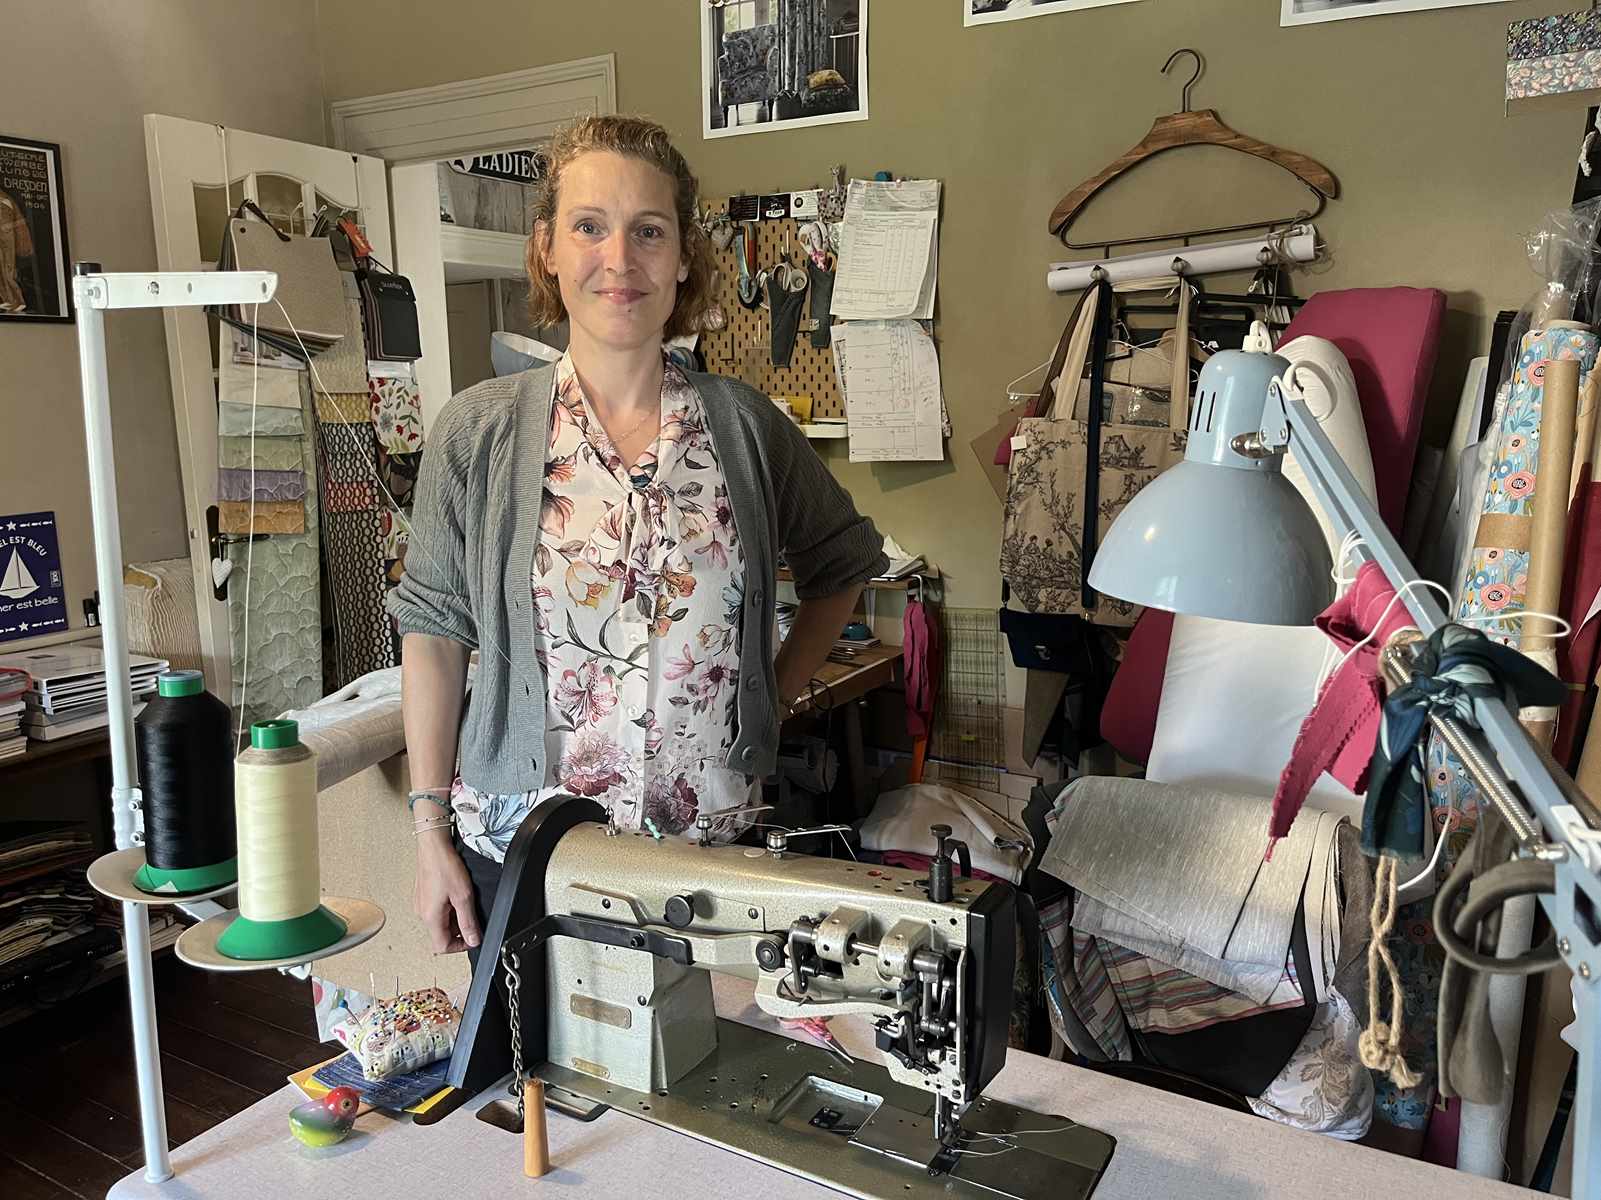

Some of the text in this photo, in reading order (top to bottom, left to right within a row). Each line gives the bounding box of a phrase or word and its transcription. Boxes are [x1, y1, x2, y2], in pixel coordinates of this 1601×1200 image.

[479, 152, 539, 180] LADIES
[4, 177, 47, 192] DRESDEN
[9, 536, 26, 544] EST
[27, 539, 47, 556] BLEU
[16, 600, 33, 609] est
[35, 596, 58, 606] belle
